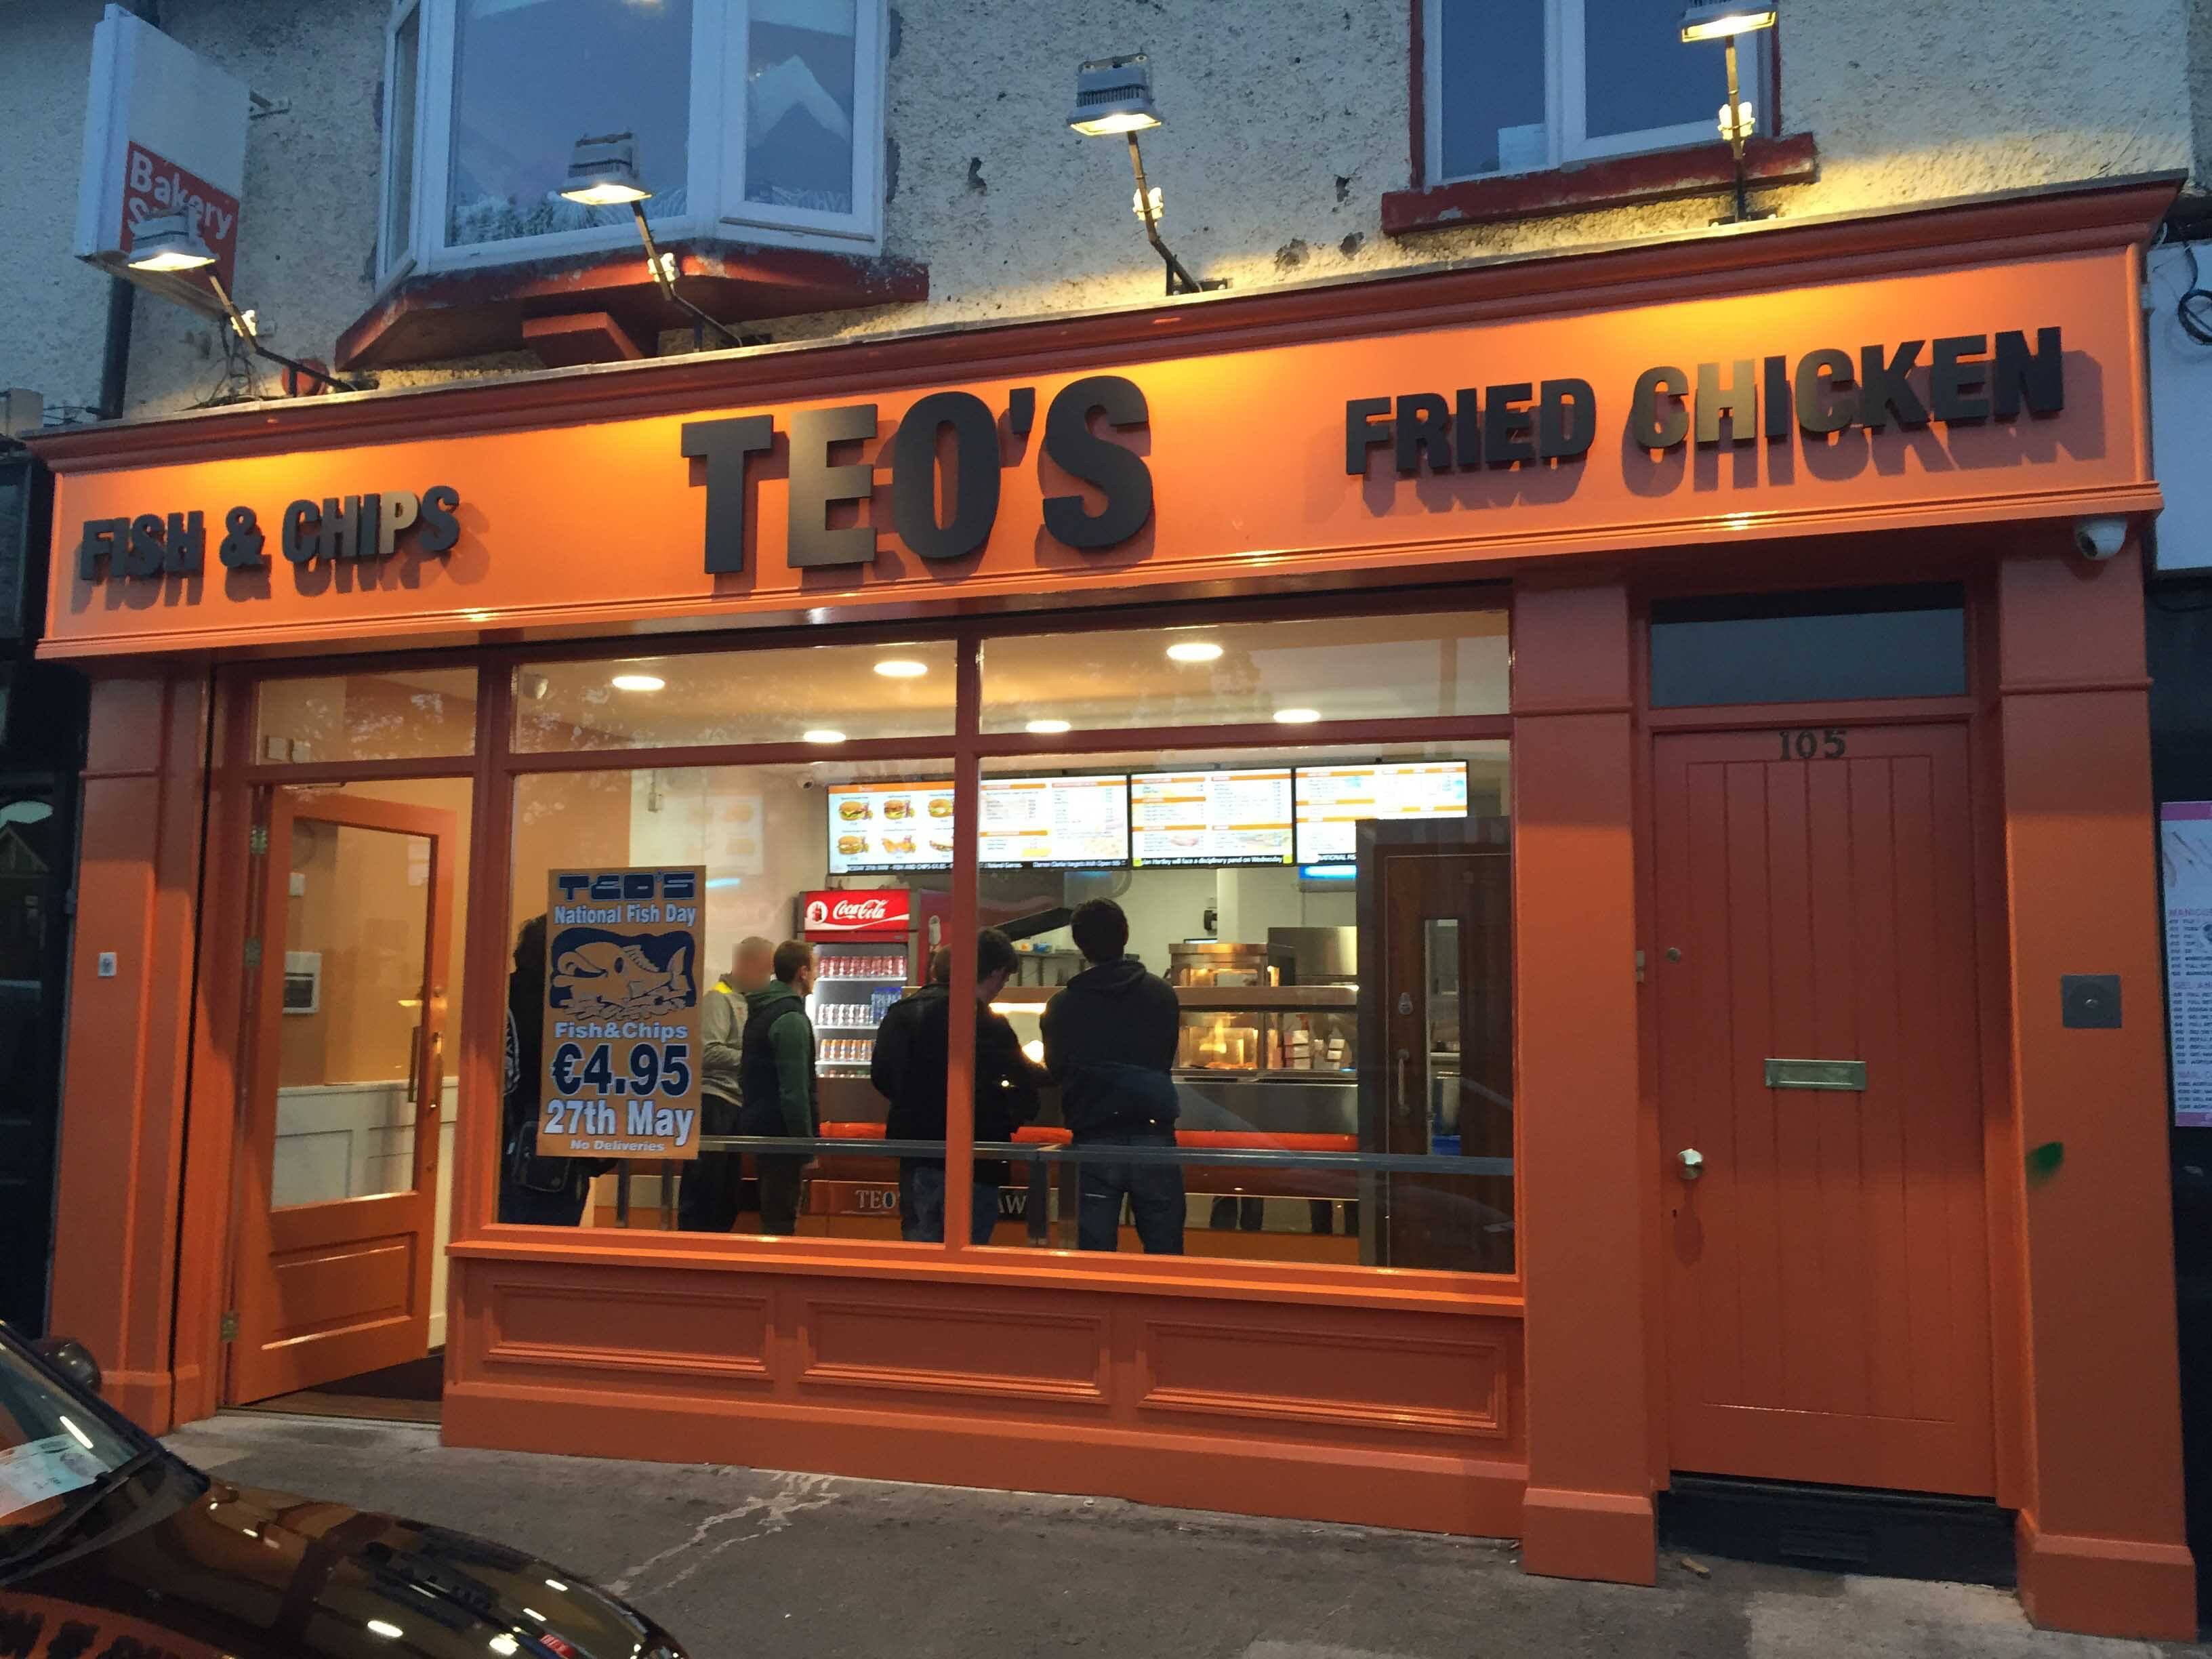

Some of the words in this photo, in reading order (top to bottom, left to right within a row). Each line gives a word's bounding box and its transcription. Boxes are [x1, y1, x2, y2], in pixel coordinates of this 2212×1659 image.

[130, 150, 232, 239] Bakery
[1346, 377, 1596, 475] FRIED
[1633, 326, 2064, 449] CHICKEN
[681, 375, 1153, 574] TEO'S
[80, 510, 204, 581] FISH
[220, 506, 265, 569] &
[282, 485, 461, 564] CHIPS
[1779, 728, 1847, 759] 105
[558, 870, 695, 901] TEO'S
[554, 905, 621, 924] National
[626, 903, 660, 923] Fish
[665, 903, 697, 927] Day
[554, 1021, 689, 1042] Fish&Chips
[551, 1042, 691, 1097] €4.95
[544, 1098, 616, 1135] 27th
[626, 1099, 695, 1147] May
[570, 1139, 590, 1151] No
[593, 1140, 665, 1151] Deliveries
[855, 1189, 901, 1209] TEO
